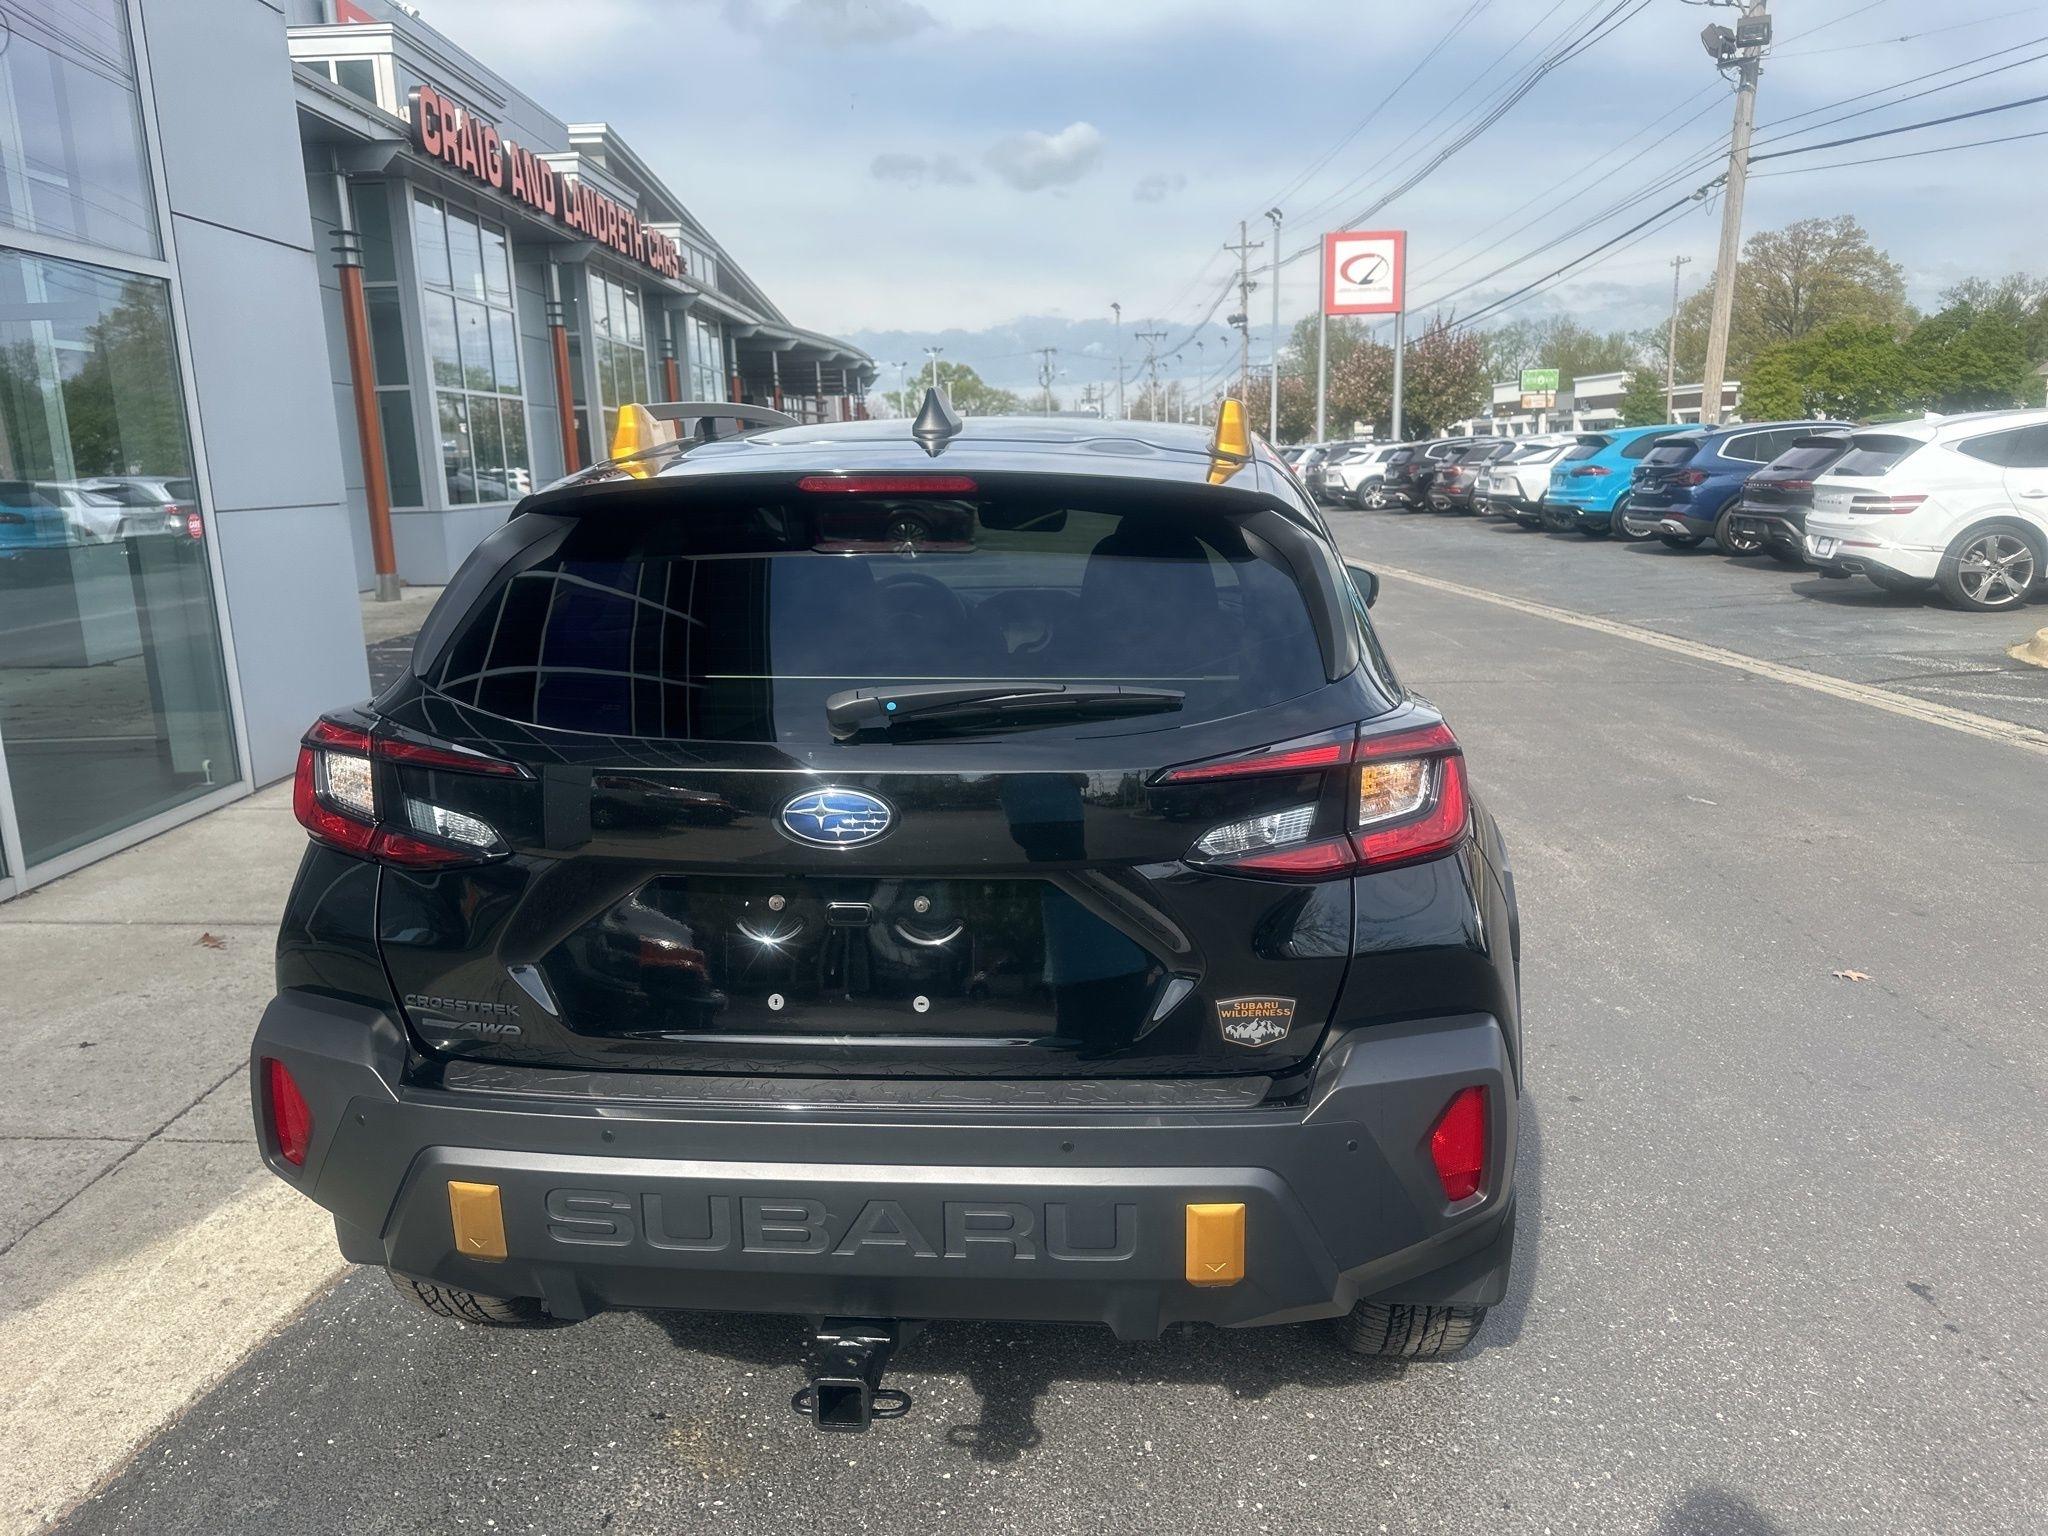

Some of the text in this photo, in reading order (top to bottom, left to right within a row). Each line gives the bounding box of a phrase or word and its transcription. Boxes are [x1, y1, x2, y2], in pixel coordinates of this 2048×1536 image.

[418, 84, 680, 280] CRAIG AND LANDRETH CARS
[404, 994, 520, 1017] CROSSTREK
[1220, 1008, 1292, 1018] WILDERNESS
[1233, 1001, 1279, 1010] SUBARU
[456, 1021, 522, 1036] AWD
[544, 1187, 1138, 1262] SUBARU
